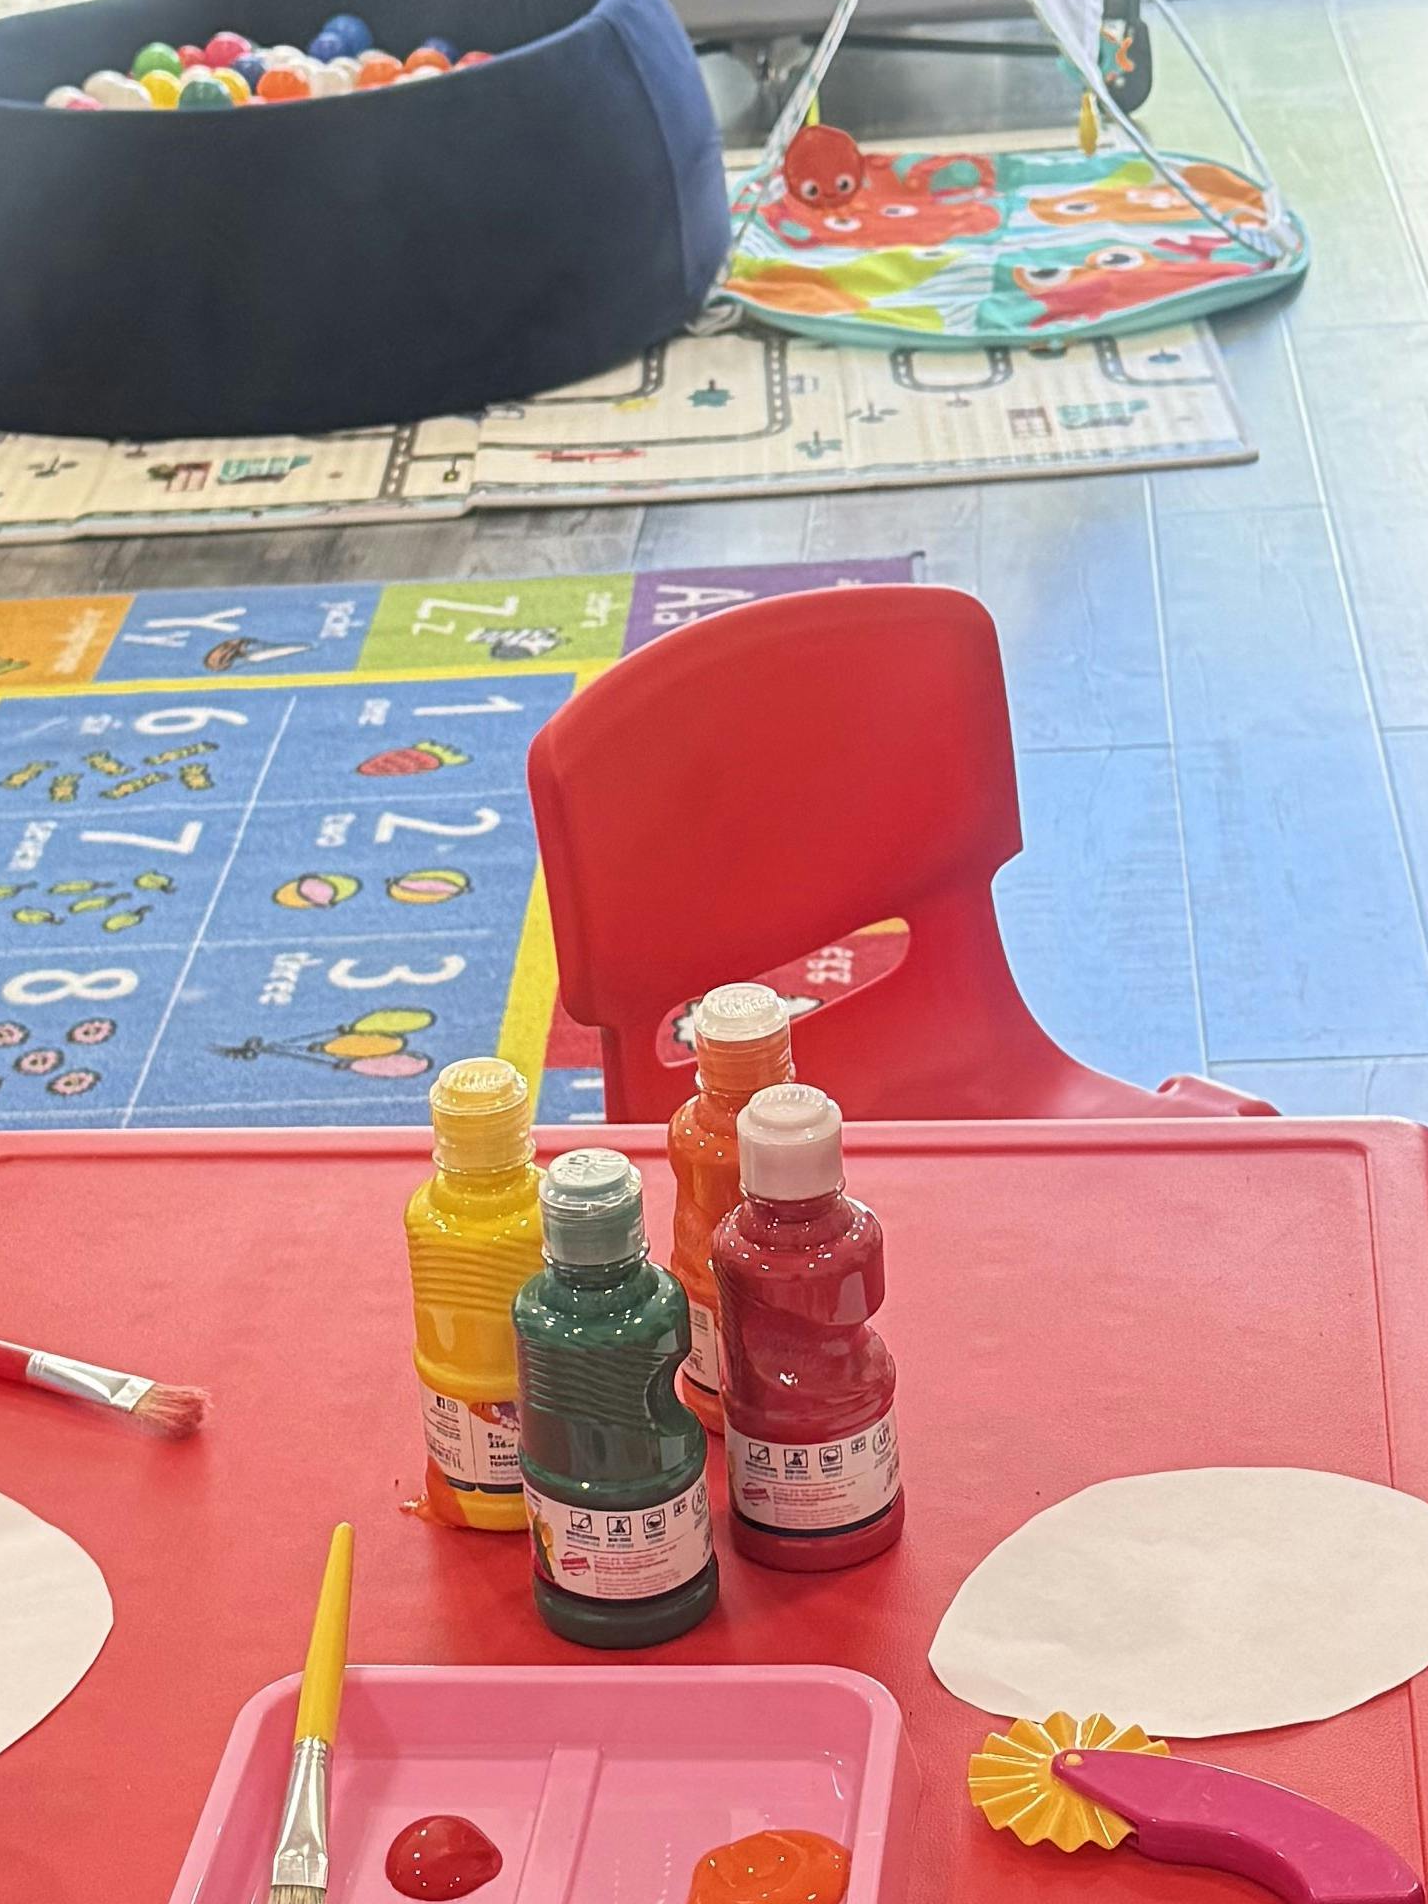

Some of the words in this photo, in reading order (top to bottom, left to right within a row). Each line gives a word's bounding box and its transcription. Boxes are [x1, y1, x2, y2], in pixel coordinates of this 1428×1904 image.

[122, 606, 248, 648] Yy
[411, 594, 520, 637] Zz
[133, 706, 249, 736] 6
[357, 697, 392, 727] one
[412, 694, 524, 717] 1
[80, 821, 204, 855] 7
[315, 812, 358, 846] two
[374, 807, 502, 844] 2
[6, 820, 60, 871] seven
[1, 968, 139, 1006] 8
[258, 951, 324, 1007] three
[328, 953, 468, 990] 3
